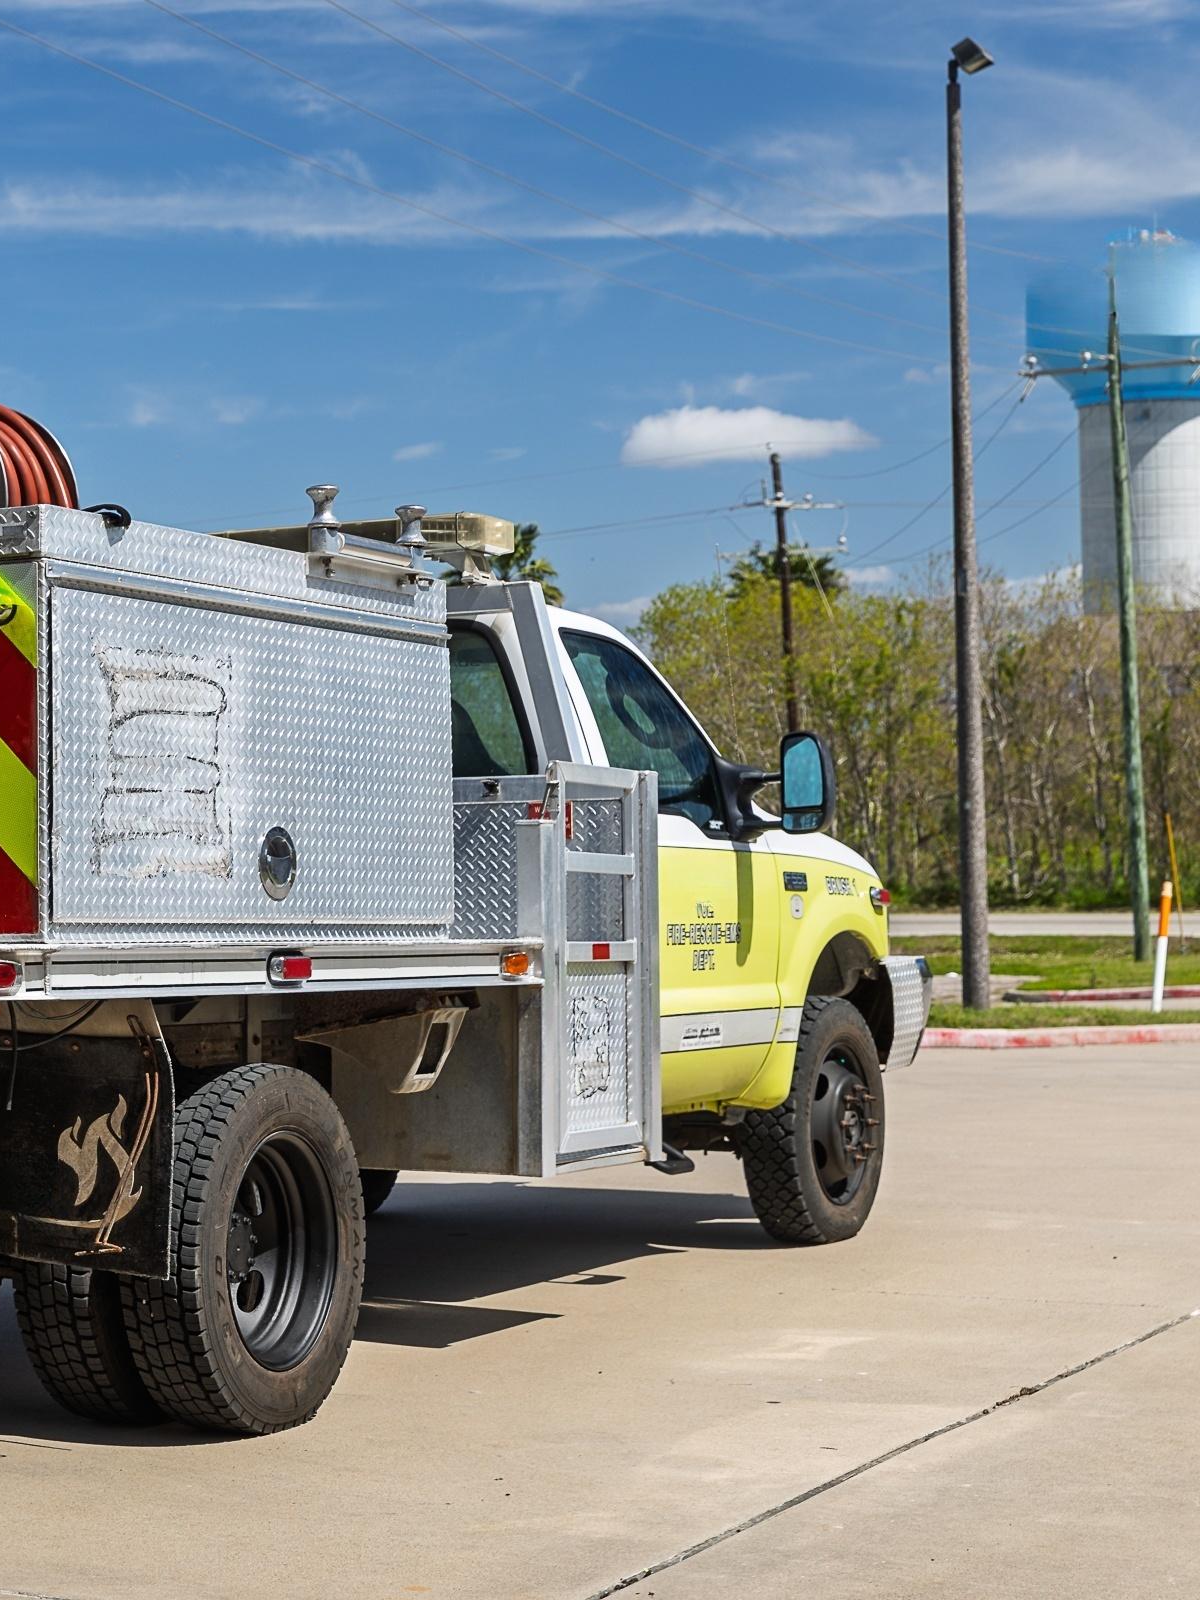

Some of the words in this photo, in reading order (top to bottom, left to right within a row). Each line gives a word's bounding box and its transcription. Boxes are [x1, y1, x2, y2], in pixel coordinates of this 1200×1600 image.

[825, 876, 854, 895] BRUSH
[666, 922, 742, 946] FIRE-RESCUE-EMS
[692, 949, 716, 971] DEPT.
